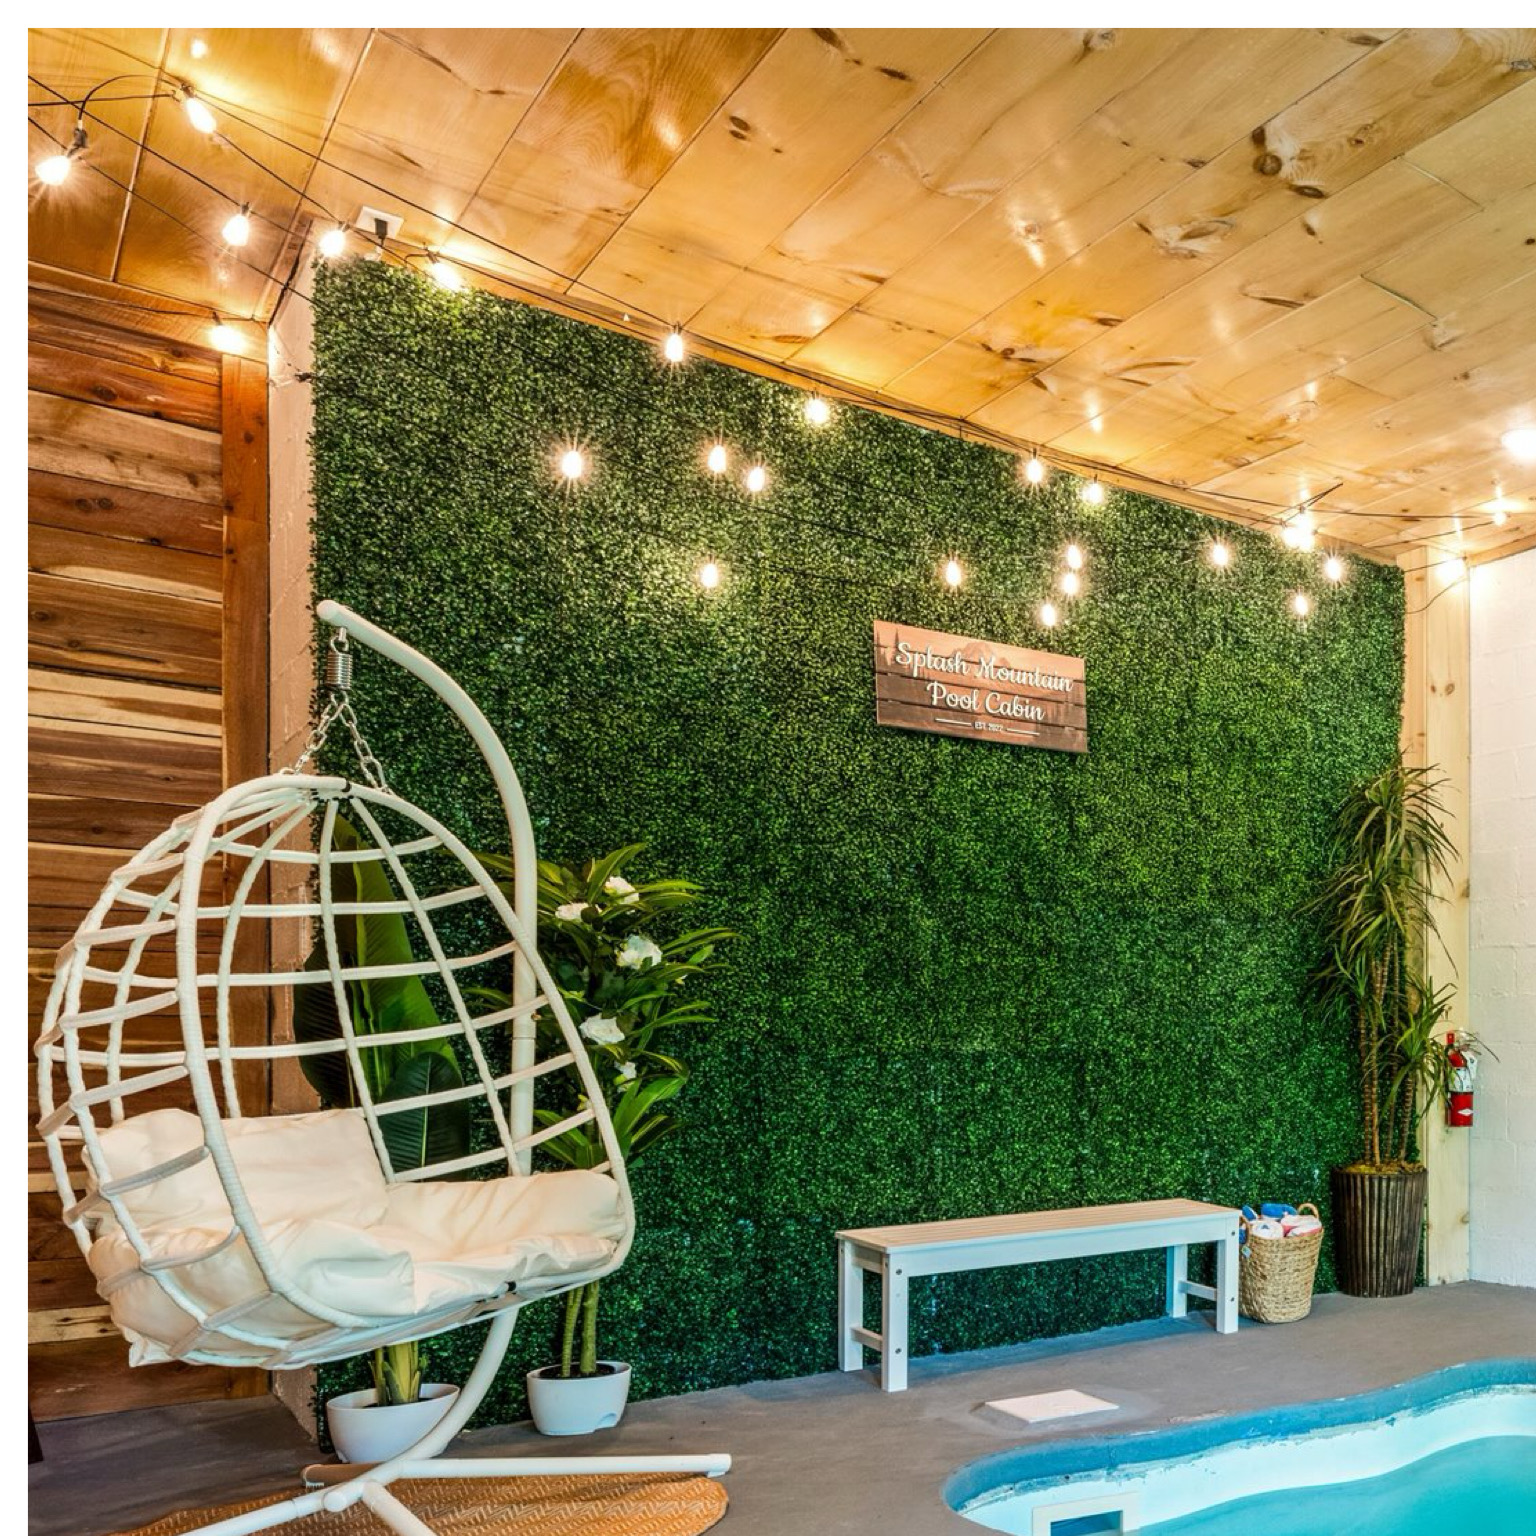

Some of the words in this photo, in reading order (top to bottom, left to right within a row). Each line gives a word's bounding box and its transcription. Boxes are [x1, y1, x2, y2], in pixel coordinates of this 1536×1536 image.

[895, 641, 969, 678] Splash
[974, 656, 1074, 692] Mountain
[926, 680, 980, 711] Pool
[985, 691, 1046, 721] Cabin
